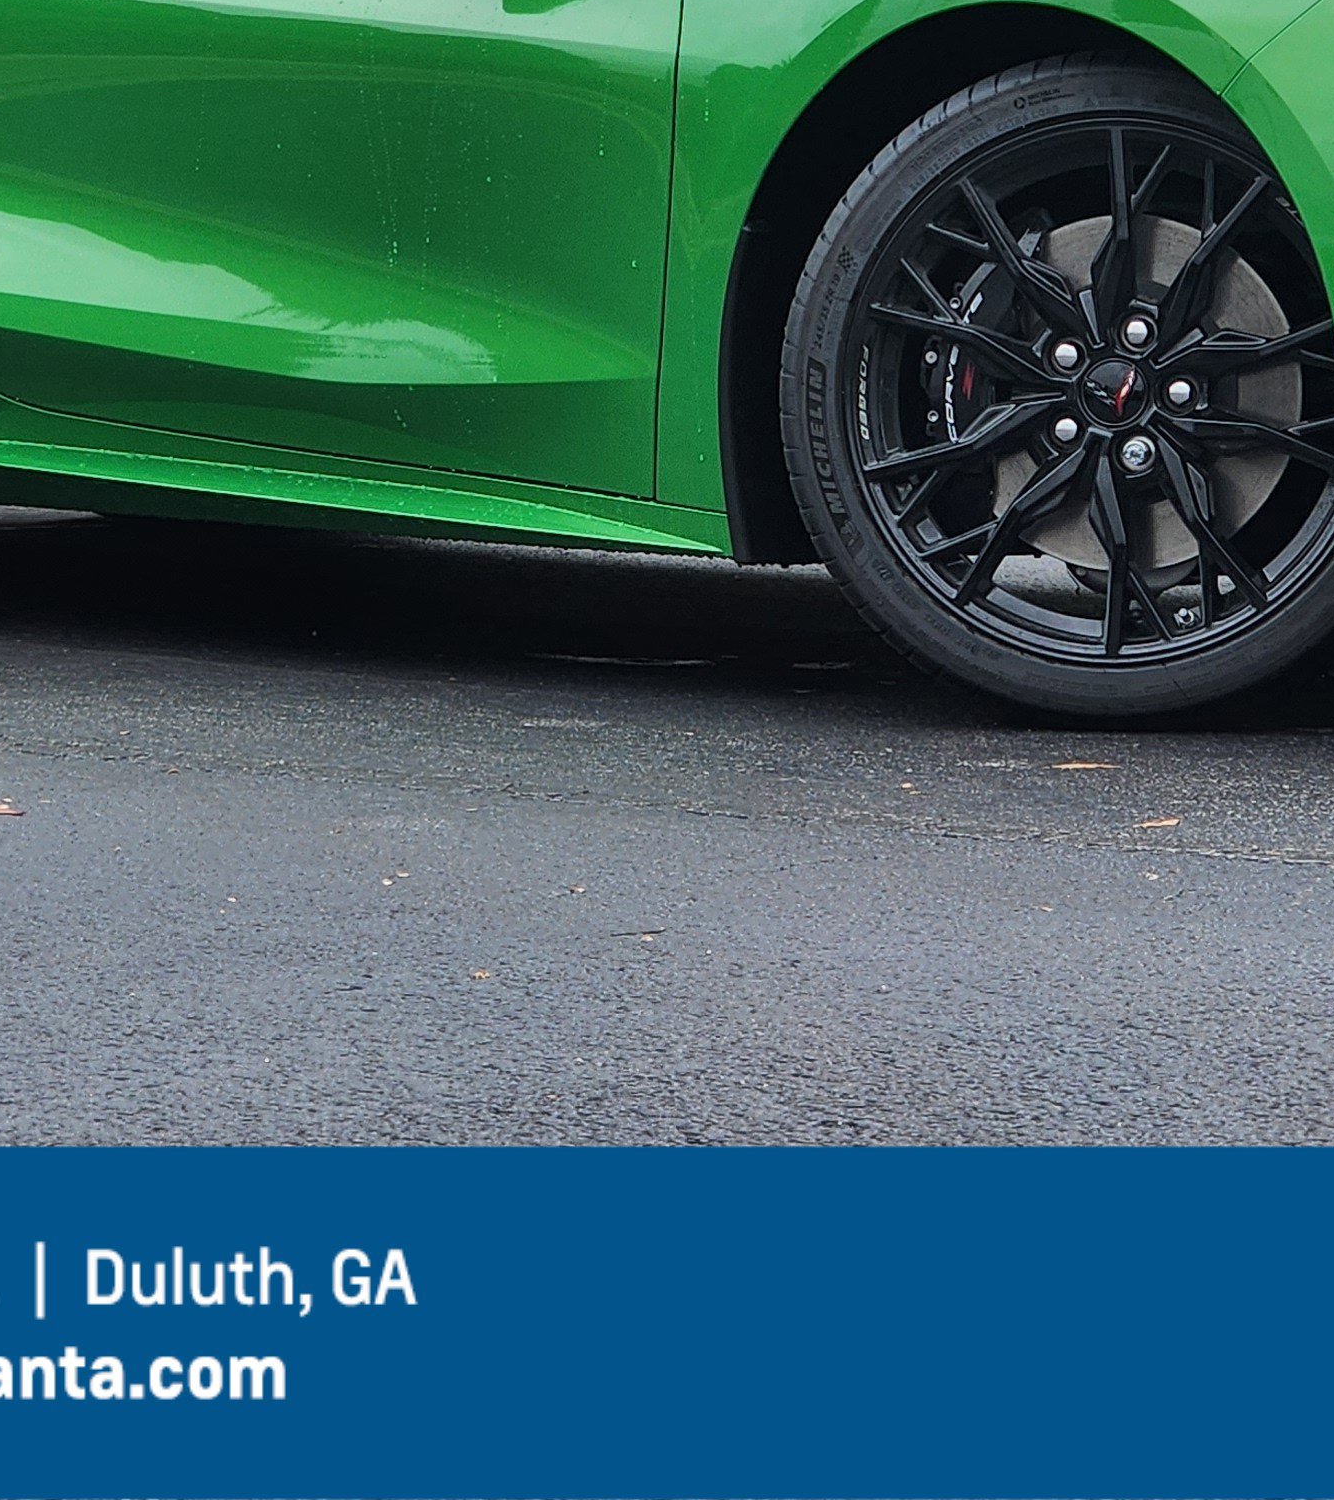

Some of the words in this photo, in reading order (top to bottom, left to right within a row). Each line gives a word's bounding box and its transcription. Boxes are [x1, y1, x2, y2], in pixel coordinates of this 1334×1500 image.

[809, 366, 848, 516] MICHELIN
[857, 344, 870, 441] FORGED
[945, 292, 984, 443] CORVETE
